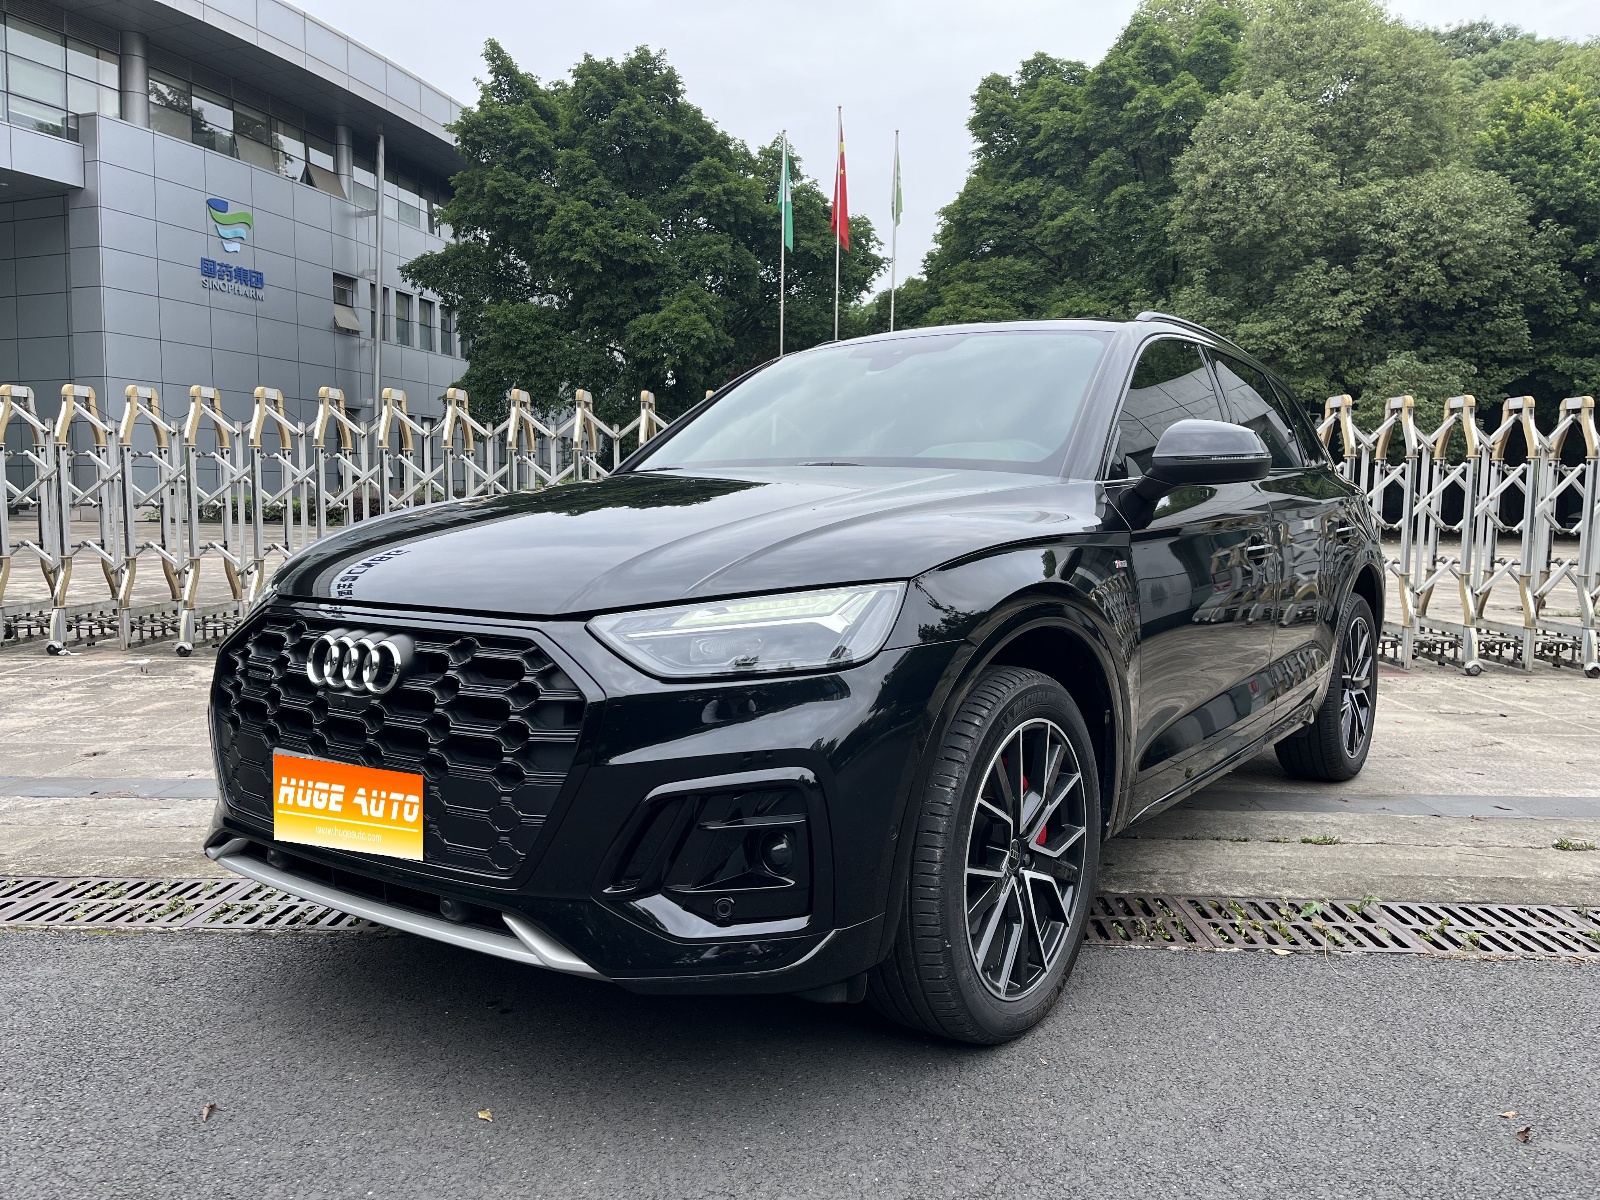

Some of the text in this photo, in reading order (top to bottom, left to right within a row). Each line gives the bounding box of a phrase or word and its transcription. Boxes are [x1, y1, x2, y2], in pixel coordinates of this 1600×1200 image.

[201, 257, 264, 289] 国药集团
[201, 279, 264, 302] SINOPHARM
